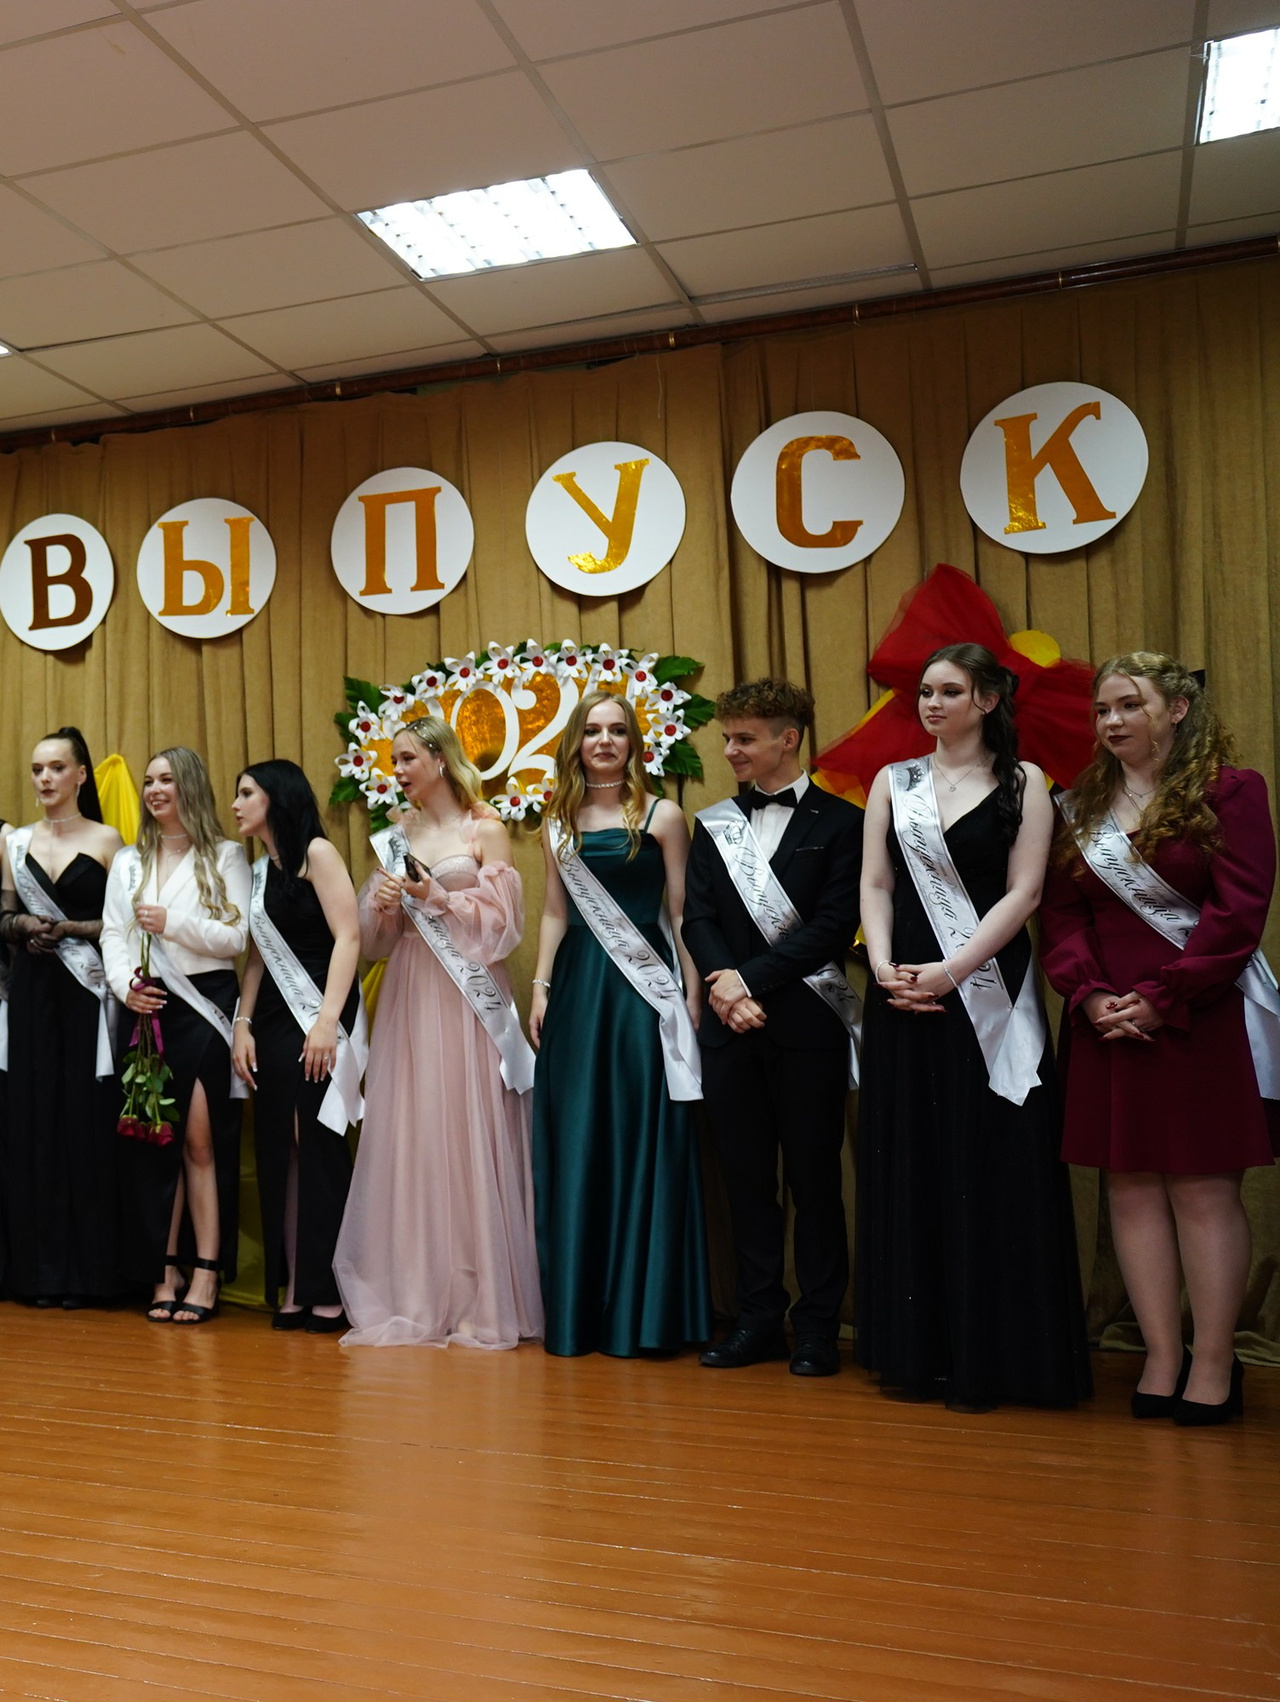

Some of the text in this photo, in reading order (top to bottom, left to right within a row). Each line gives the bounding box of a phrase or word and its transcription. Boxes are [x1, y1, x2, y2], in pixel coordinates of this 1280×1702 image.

[23, 401, 1117, 632] ВЫПУСК
[901, 793, 958, 922] Выпускница
[1089, 819, 1182, 924] Выпускница
[559, 850, 631, 949] Выпускница
[625, 950, 679, 1000] 2024
[456, 961, 504, 1013] 2024
[816, 968, 857, 1001] 024
